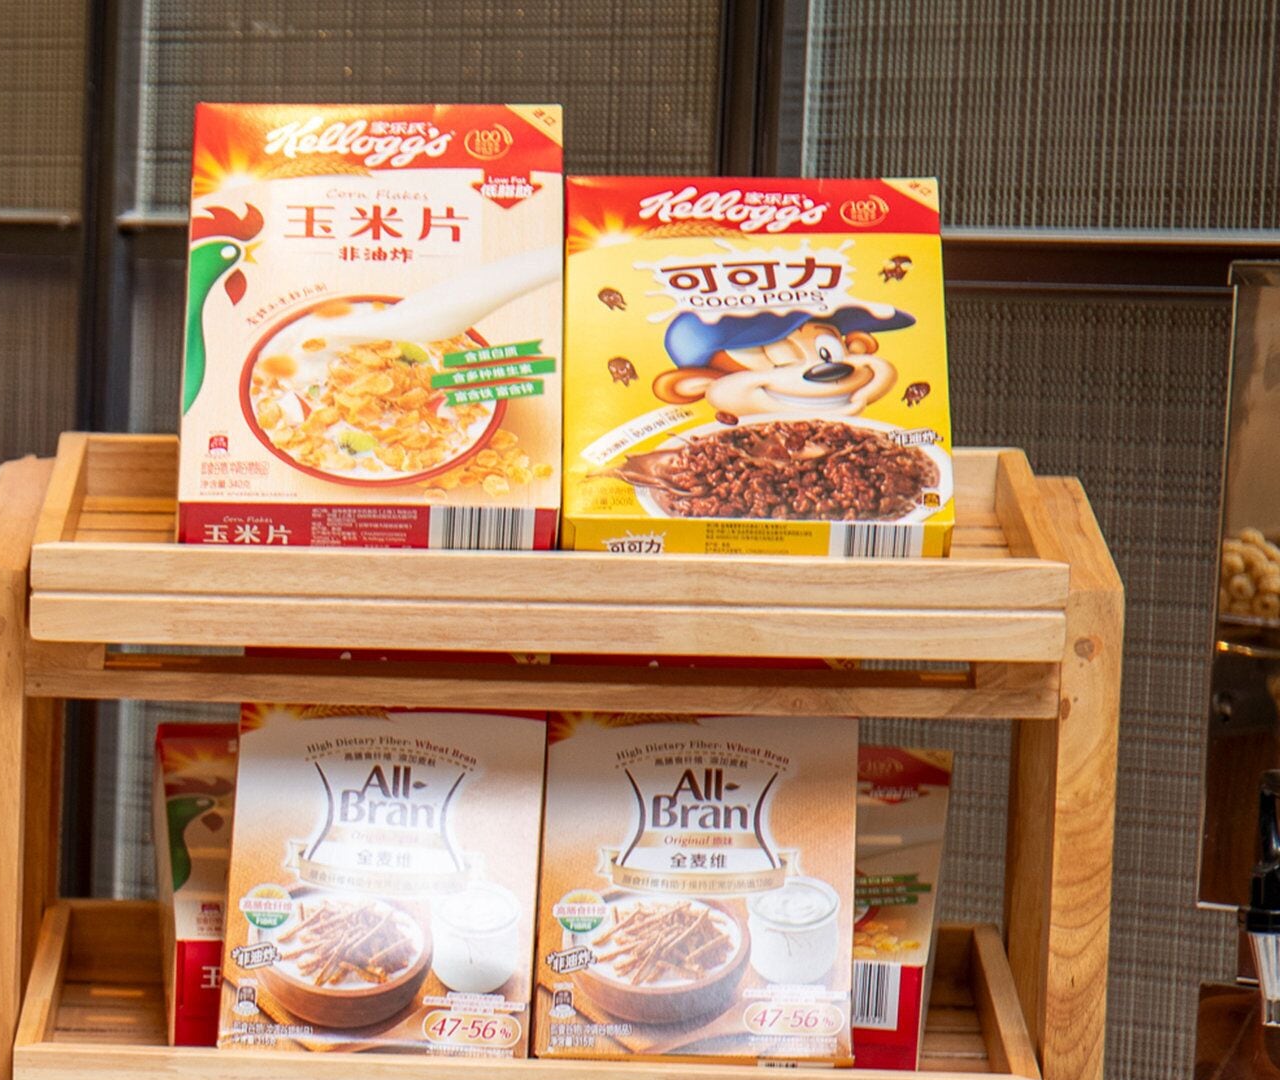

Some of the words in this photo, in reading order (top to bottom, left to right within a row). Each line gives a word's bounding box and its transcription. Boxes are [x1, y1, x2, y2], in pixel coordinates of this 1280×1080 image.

[370, 120, 427, 136] 家乐氏
[264, 117, 452, 167] Kellogg's
[488, 175, 509, 184] Low
[511, 176, 527, 184] Fat
[325, 188, 368, 200] Corn
[375, 188, 431, 201] Flakes
[743, 191, 801, 207] 家乐氏
[638, 186, 827, 233] Kellogg's
[283, 203, 470, 243] 玉米片
[338, 245, 414, 264] 非油炸
[660, 256, 843, 295] 可可力
[688, 293, 757, 309] COCO
[762, 289, 825, 305] POPS
[464, 344, 519, 363] 含蛋白质
[452, 362, 533, 385] 含多种维生素
[202, 523, 293, 545] 玉米片
[608, 538, 663, 554] 可可力
[306, 741, 333, 754] High
[336, 737, 377, 748] Dietary
[415, 738, 450, 754] Wheat
[452, 750, 477, 766] Bran
[616, 747, 643, 761] High
[646, 741, 686, 754] Dietary
[726, 741, 761, 757] Wheat
[763, 750, 790, 766] Bran
[340, 789, 434, 829] Bran
[652, 794, 748, 829] Bran
[664, 834, 710, 846] Original
[356, 848, 414, 869] 全麦维
[670, 852, 728, 869] 全麦维
